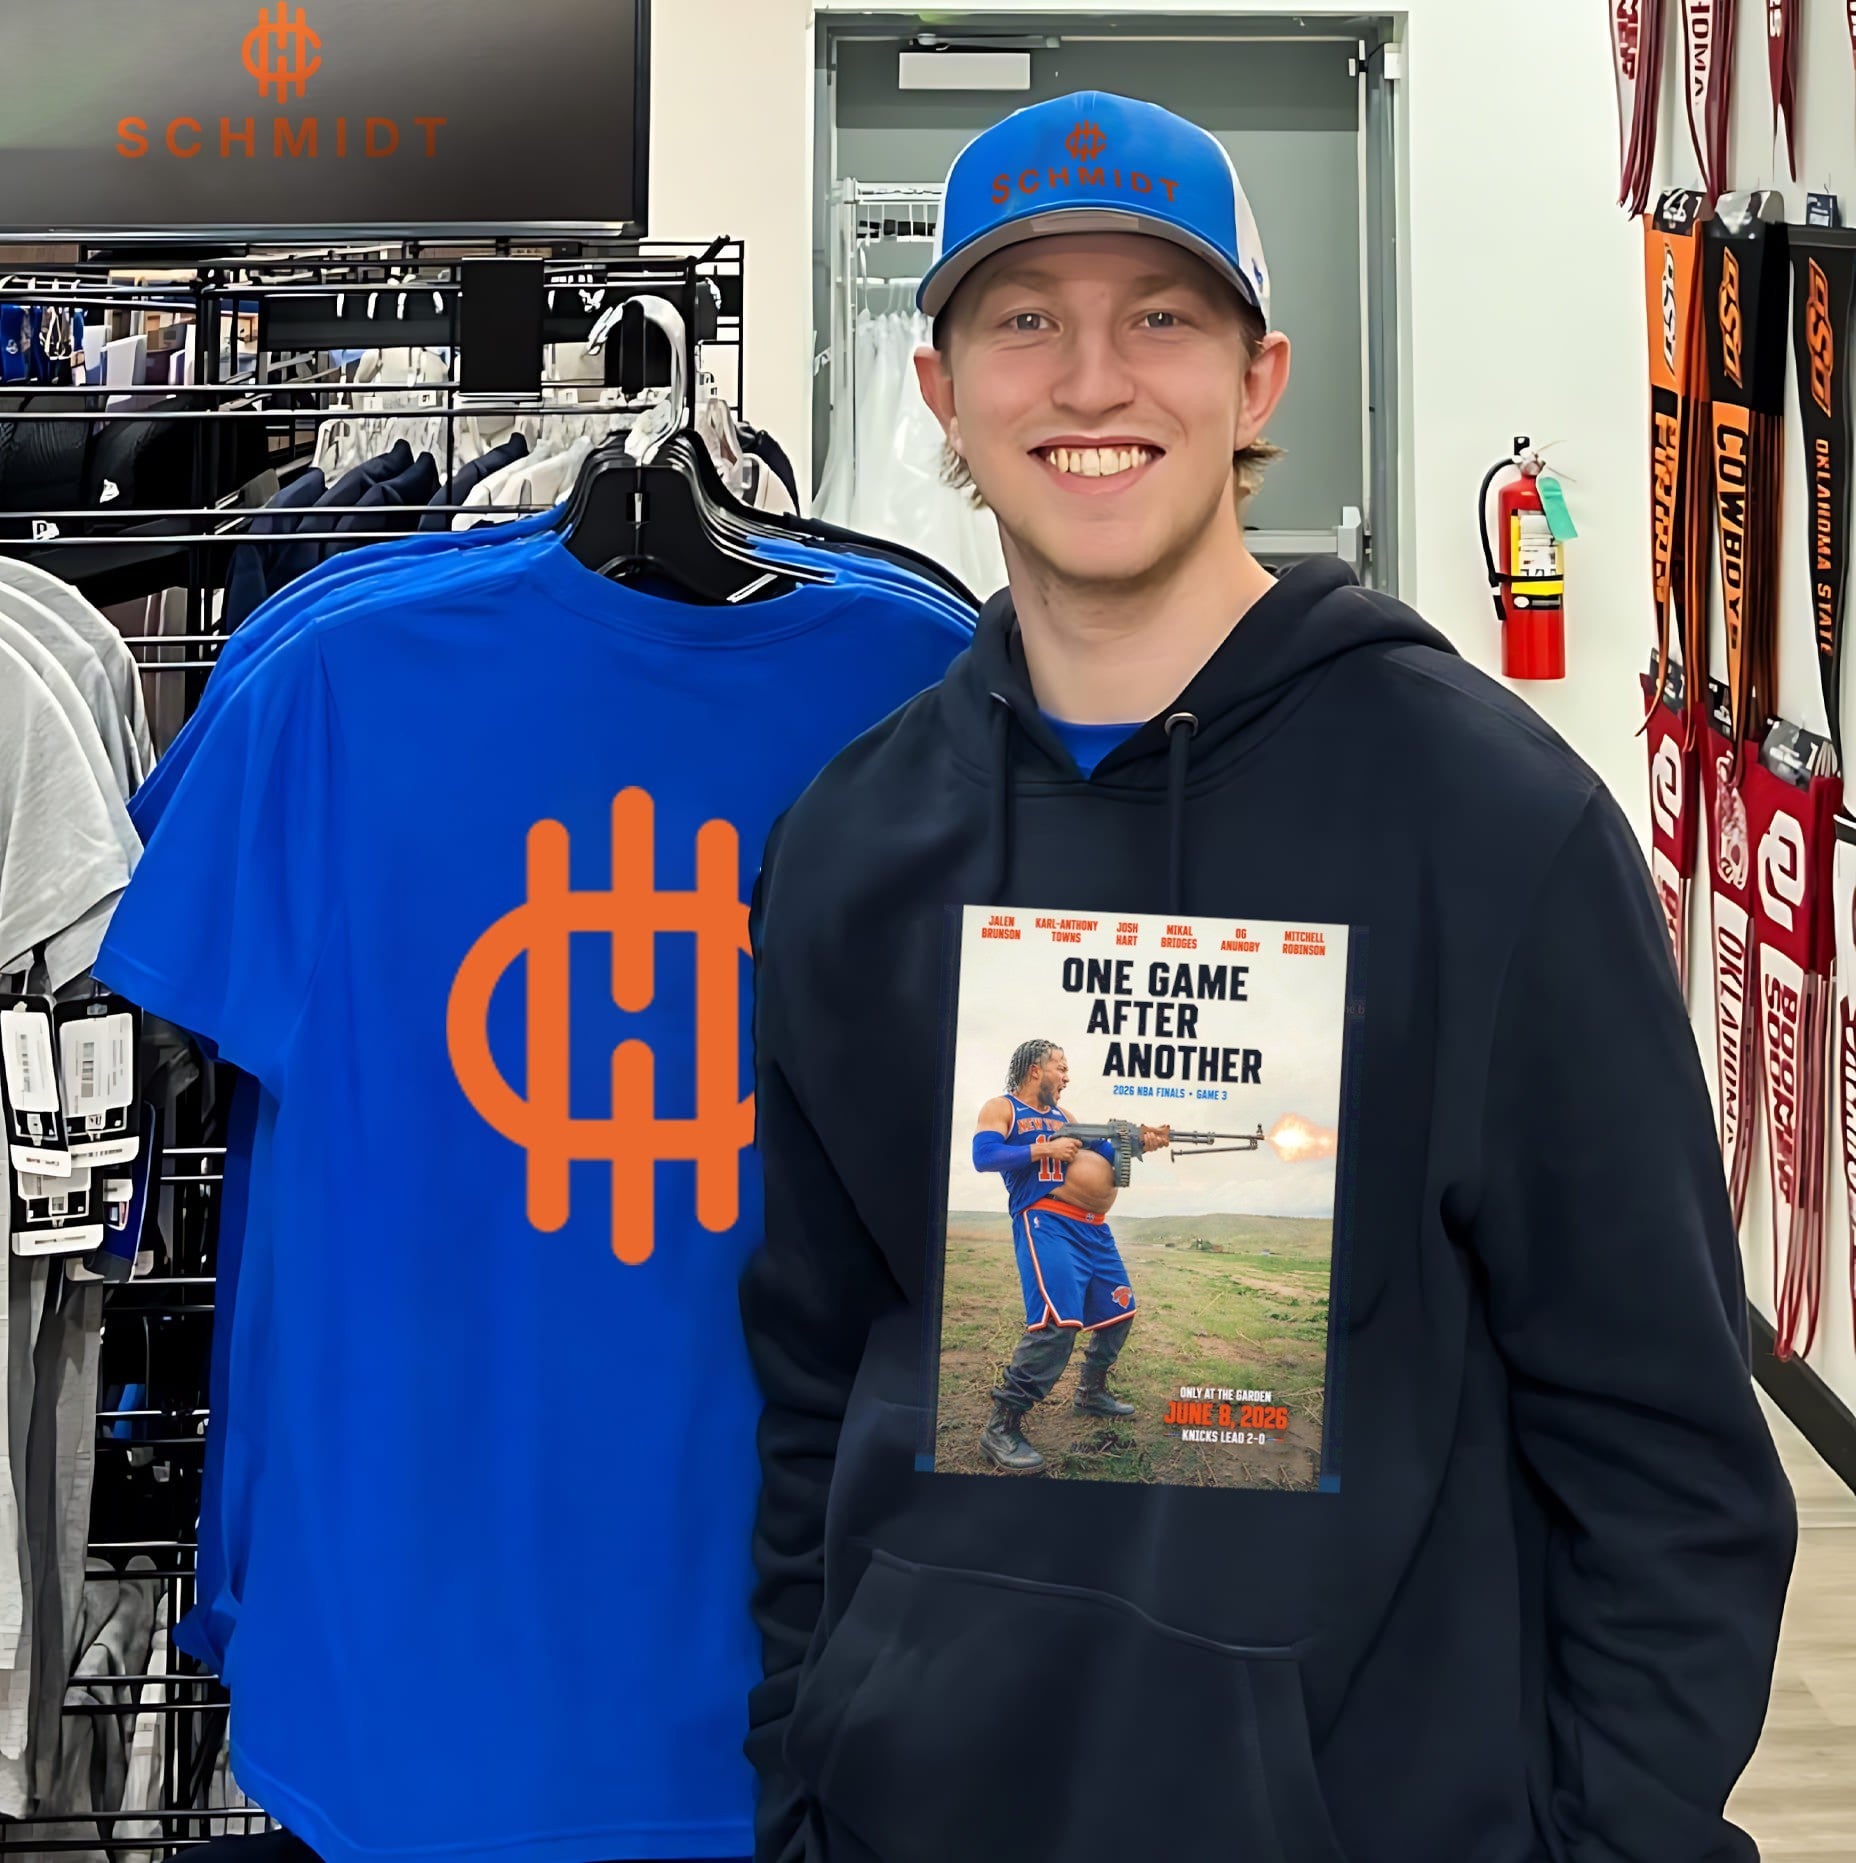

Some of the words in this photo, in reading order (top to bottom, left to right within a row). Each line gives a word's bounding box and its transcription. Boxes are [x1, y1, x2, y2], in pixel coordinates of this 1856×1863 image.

[116, 116, 447, 159] SCHMIDT
[992, 167, 1179, 205] SCHMIDT
[1815, 438, 1832, 570] OKLAHOMA
[989, 916, 1015, 926] JALEN
[1035, 918, 1098, 931] KARL-ANTHONY
[1116, 922, 1138, 934] JOSH
[981, 928, 1021, 940] BRUNSON
[1051, 931, 1082, 943] TOWNS
[1166, 924, 1193, 936] MIKAL
[1235, 928, 1247, 940] OG
[1284, 931, 1325, 943] MITCHELL
[1116, 934, 1138, 946] HART
[1160, 937, 1198, 949] BRIDGES
[1220, 940, 1261, 953] ANUNOBY
[1282, 943, 1326, 956] ROBINSON
[1062, 957, 1134, 995] ONE
[1148, 962, 1249, 1001] GAME
[1086, 999, 1199, 1039] AFTER
[1102, 1042, 1263, 1084] ANOTHER
[1113, 1085, 1135, 1096] 2026
[1137, 1086, 1154, 1097] NBA
[1156, 1086, 1185, 1098] FINALS
[1196, 1090, 1220, 1100] GAME
[1221, 1091, 1228, 1100] 3
[1017, 1117, 1043, 1134] NEW
[1036, 1134, 1064, 1181] 11
[1180, 1386, 1202, 1399] ONLY
[1204, 1388, 1217, 1400] AT
[1218, 1388, 1234, 1400] THE
[1236, 1390, 1272, 1402] GARDEN
[1163, 1401, 1213, 1426] JUNE
[1218, 1403, 1236, 1429] 8,
[1240, 1405, 1289, 1430] 2026
[1182, 1429, 1218, 1442] KNICKS
[1221, 1431, 1245, 1444] LEAD
[1247, 1432, 1266, 1445] 2-0
